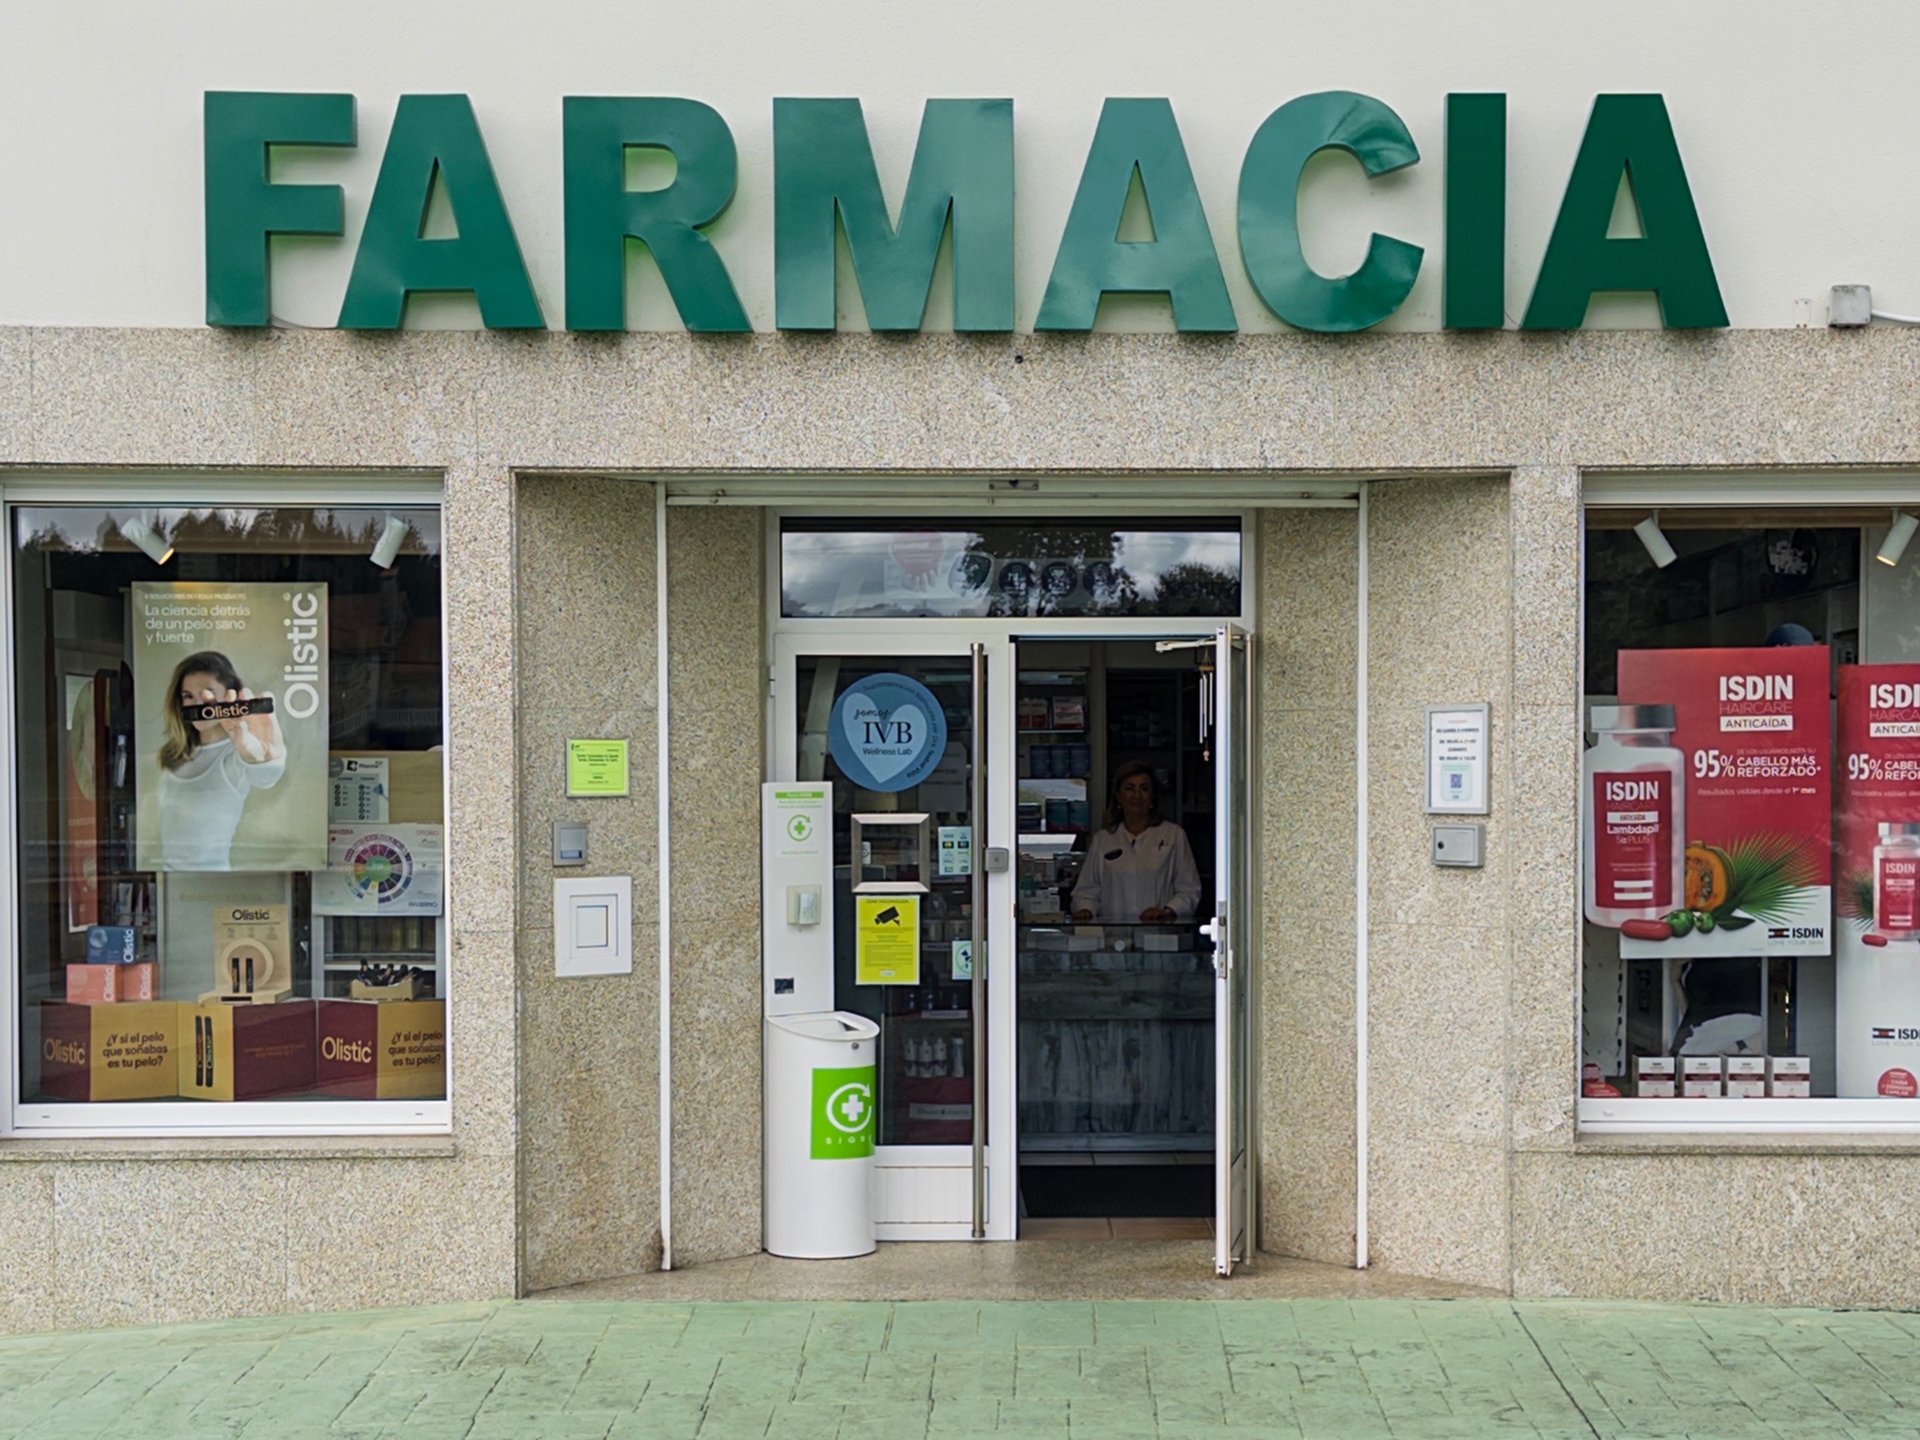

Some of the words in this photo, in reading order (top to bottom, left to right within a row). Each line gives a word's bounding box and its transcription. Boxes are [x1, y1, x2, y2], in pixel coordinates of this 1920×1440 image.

[204, 90, 1730, 334] FARMACIA
[145, 605, 159, 616] La
[161, 604, 208, 616] ciencia
[210, 604, 250, 616] detrás
[145, 618, 162, 630] de
[166, 620, 182, 630] un
[184, 618, 214, 632] pelo
[215, 620, 246, 630] sano
[146, 634, 154, 646] y
[156, 631, 195, 644] fuerte
[284, 592, 320, 720] Olistic
[1720, 674, 1793, 702] ISDIN
[201, 704, 249, 720] Olistic
[1720, 701, 1793, 714] HAIRCARE
[1725, 718, 1788, 728] ANTICAÍDA
[1874, 724, 1920, 734] ANTICAÍ
[863, 721, 912, 744] IVB
[862, 747, 896, 756] Wellness
[898, 747, 912, 756] Lab
[1694, 748, 1736, 778] 95%
[1737, 756, 1789, 766] CABELLO
[1791, 753, 1816, 766] MÁS
[1848, 753, 1884, 780] 95%
[1606, 781, 1659, 801] ISDIN
[1606, 824, 1660, 836] Lambdapil
[1886, 862, 1916, 874] ISDIN
[232, 909, 270, 920] Olistic
[1792, 928, 1824, 938] ISDIN
[123, 928, 134, 963] Olistic
[106, 1033, 118, 1046] ¿Y
[120, 1032, 128, 1043] si
[130, 1032, 140, 1042] el
[141, 1031, 165, 1046] pelo
[391, 1032, 402, 1045] ¿Y
[403, 1032, 411, 1042] si
[412, 1031, 422, 1042] el
[422, 1030, 443, 1043] pelo
[44, 1038, 86, 1064] Olistic
[102, 1048, 122, 1058] que
[124, 1044, 168, 1056] soñabas
[322, 1036, 372, 1064] Olistic
[388, 1046, 406, 1057] que
[108, 1059, 120, 1068] es
[122, 1058, 133, 1068] tu
[134, 1056, 164, 1070] pelo?
[392, 1058, 404, 1066] es
[405, 1057, 415, 1066] tu
[416, 1054, 441, 1068] pelo?
